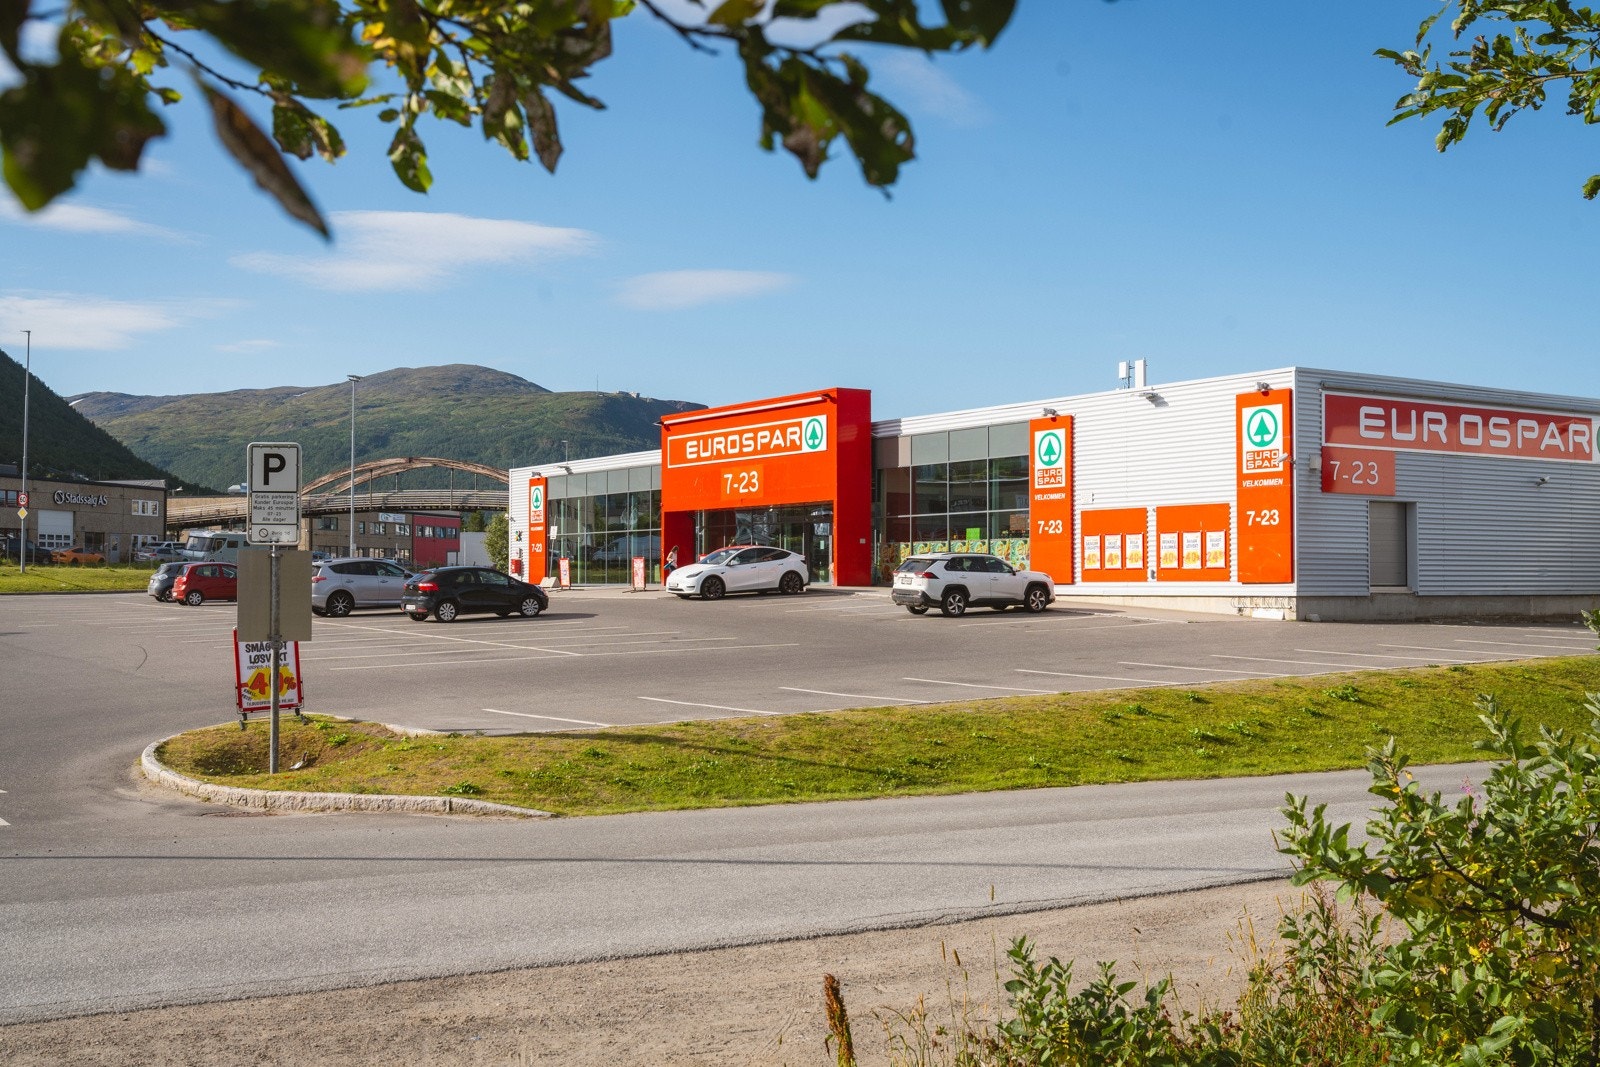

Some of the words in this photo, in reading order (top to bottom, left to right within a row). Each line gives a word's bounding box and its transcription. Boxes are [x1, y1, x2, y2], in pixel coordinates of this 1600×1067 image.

[1359, 405, 1591, 454] EUROSPAR
[685, 426, 801, 460] EUROSPAR
[1246, 450, 1280, 461] EURO
[263, 453, 286, 486] P
[1246, 459, 1280, 470] SPAR
[1037, 468, 1063, 477] EURO
[1330, 460, 1379, 486] 7-23
[723, 470, 759, 495] 7-23
[1037, 476, 1063, 485] SPAR
[1242, 478, 1284, 488] VELKOMMEN
[97, 495, 108, 506] AS
[1034, 492, 1066, 501] VELKOMMEN
[1246, 509, 1280, 527] 7-23
[1037, 519, 1063, 534] 7-23
[245, 641, 288, 653] SMÅGDT
[249, 652, 288, 665] LØSVKT
